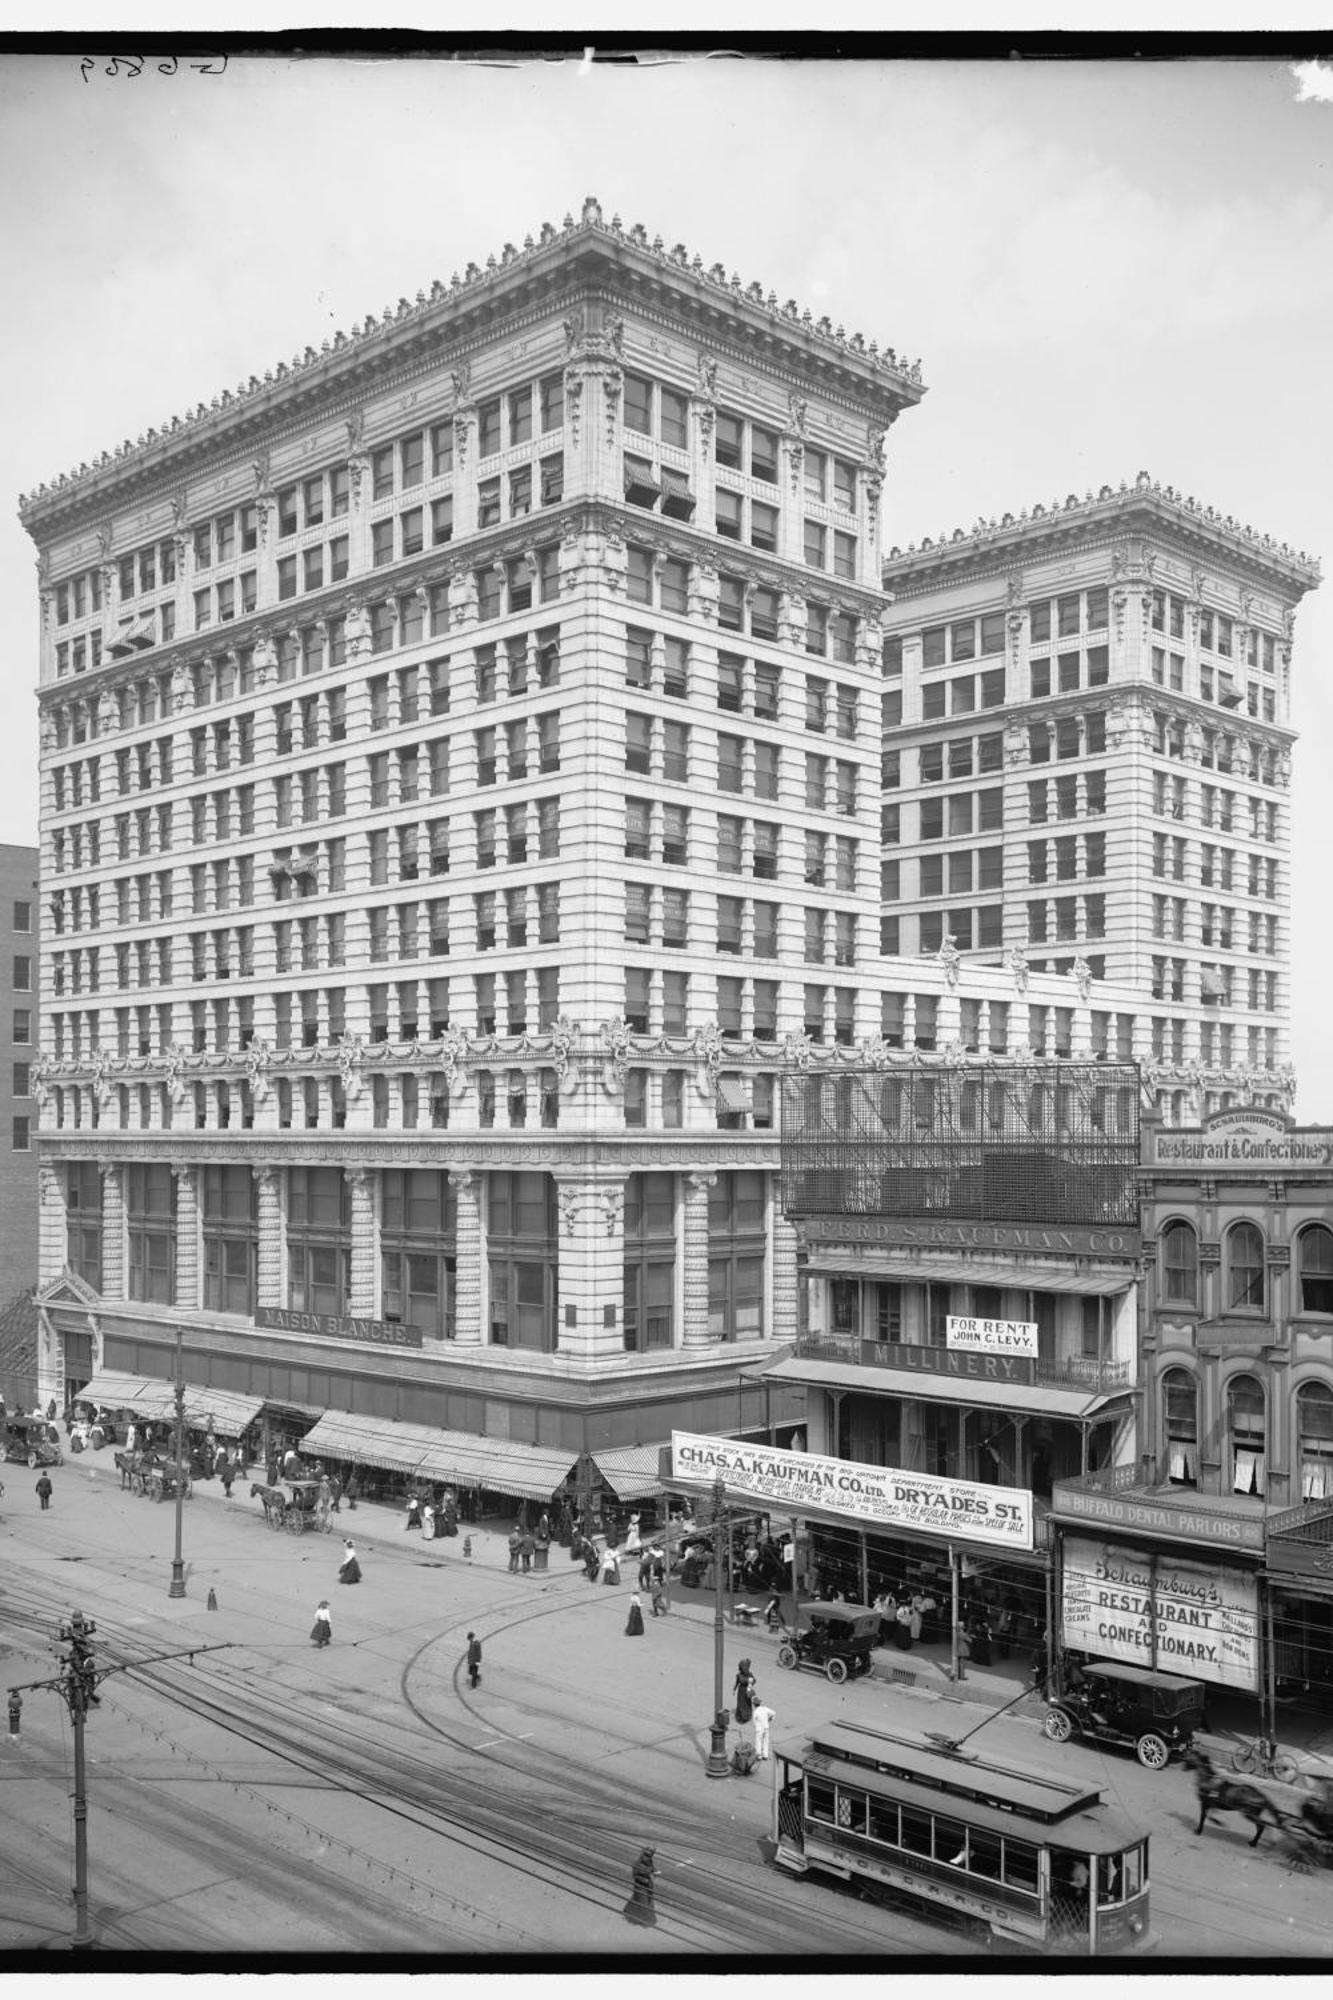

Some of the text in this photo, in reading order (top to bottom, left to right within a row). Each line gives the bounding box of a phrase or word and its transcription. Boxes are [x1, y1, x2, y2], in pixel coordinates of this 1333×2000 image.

[1157, 1137, 1228, 1160] Restaurant
[1231, 1138, 1241, 1159] &
[931, 1226, 1073, 1248] KAUFMAN
[1089, 1233, 1128, 1252] CO.
[264, 1309, 321, 1332] MAISON
[950, 1318, 1031, 1336] FOR RENT
[953, 1331, 981, 1342] JOHN
[984, 1332, 995, 1344] C.
[997, 1335, 1034, 1348] LEVY.
[874, 1343, 1017, 1379] MILLINERY.
[679, 1447, 730, 1469] CHAS.
[733, 1457, 751, 1472] A.
[752, 1460, 836, 1489] KAUFMAN
[838, 1476, 864, 1494] CO.
[865, 1485, 886, 1498] LTD.
[894, 1486, 989, 1515] DRYADES
[995, 1503, 1023, 1521] ST.
[891, 1478, 943, 1490] DEPARTMENT
[1072, 1495, 1241, 1538] BUFFALO DENTAL PARLORS
[1099, 1590, 1213, 1628] RESTAURANT
